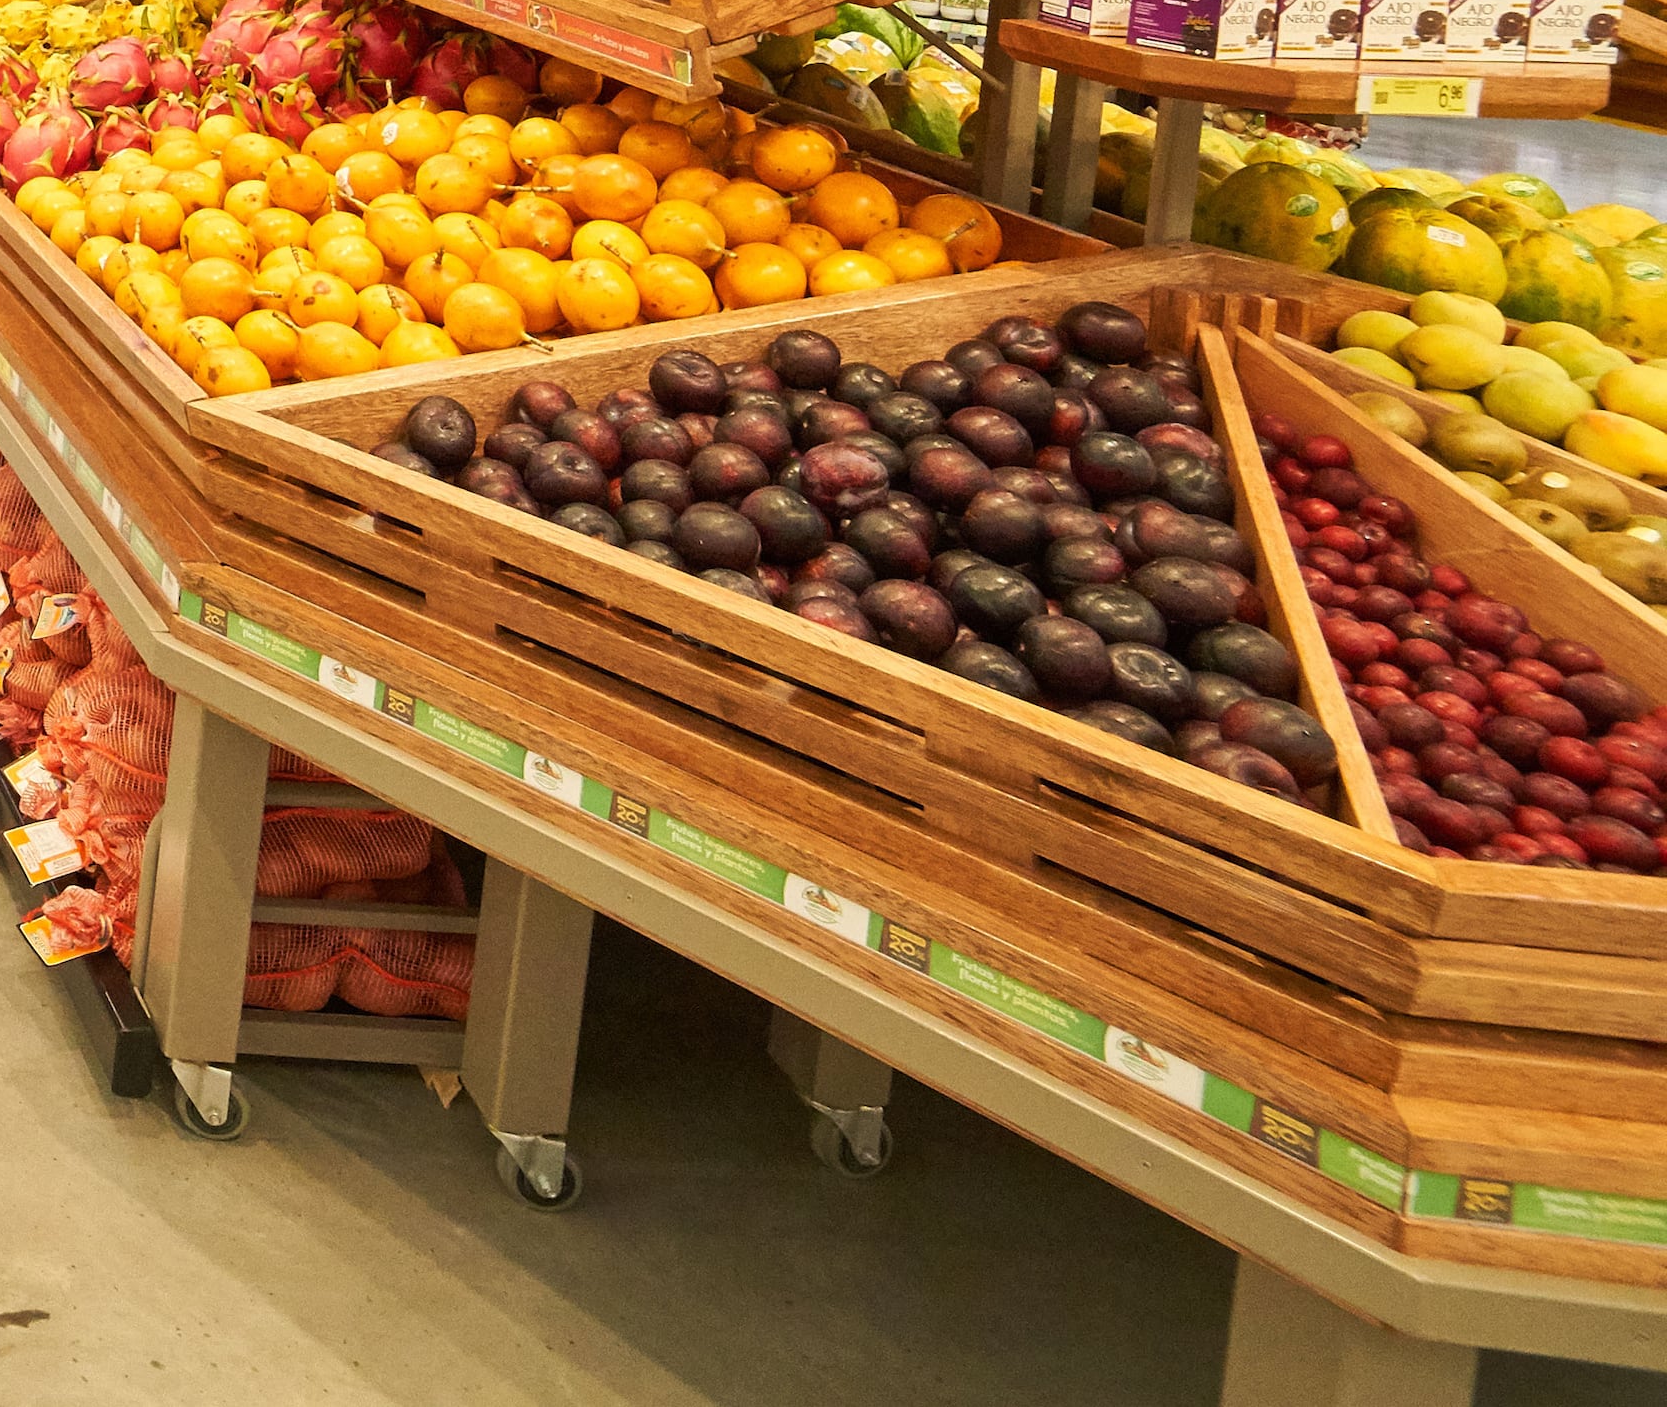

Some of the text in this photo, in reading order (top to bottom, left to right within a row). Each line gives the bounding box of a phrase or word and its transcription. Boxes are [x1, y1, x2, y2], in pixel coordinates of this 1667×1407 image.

[1236, 1, 1254, 13] AJO
[1300, 1, 1326, 12] AJO
[1387, 2, 1412, 14] AJO
[1467, 4, 1494, 15] AJO
[1555, 5, 1583, 16] AJO
[1225, 14, 1254, 25] NEGRO
[1285, 14, 1325, 24] NEGRO
[1369, 16, 1412, 26] NEGRO
[1450, 17, 1494, 27] NEGRO
[1537, 18, 1583, 28] NEGRO
[387, 696, 413, 718] 20%
[616, 805, 646, 829] 20%
[888, 935, 927, 963] 20%
